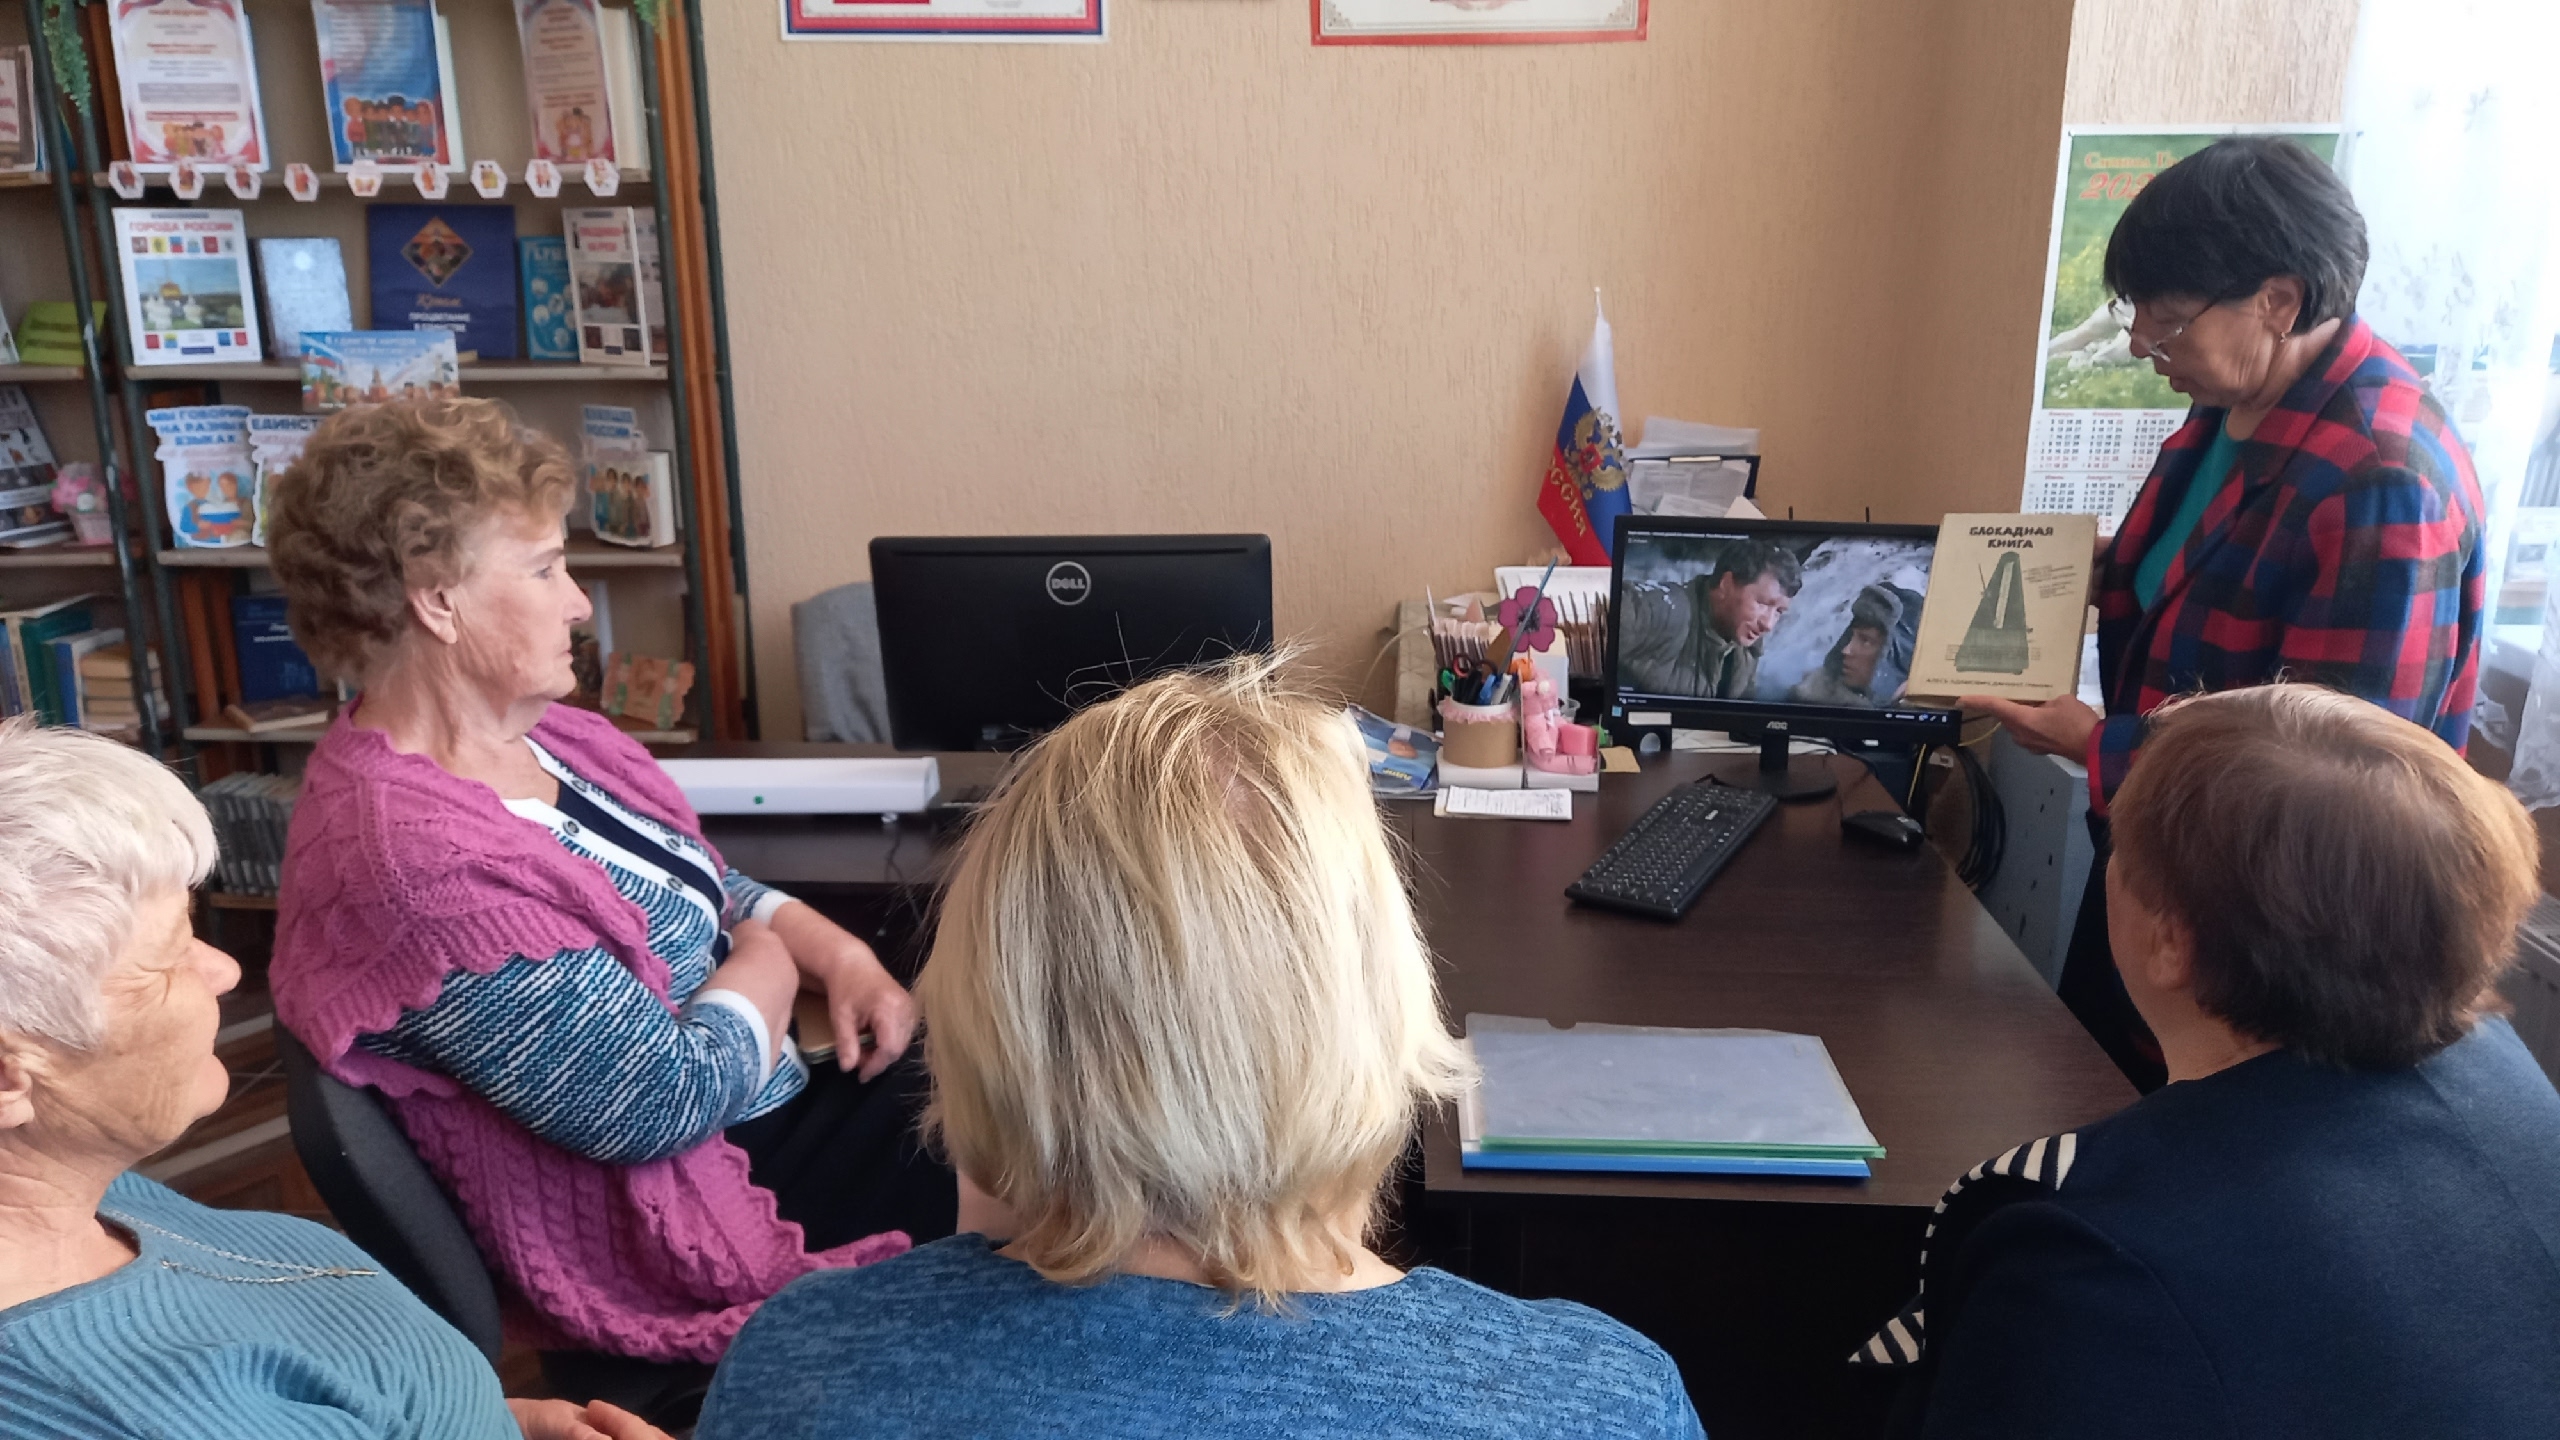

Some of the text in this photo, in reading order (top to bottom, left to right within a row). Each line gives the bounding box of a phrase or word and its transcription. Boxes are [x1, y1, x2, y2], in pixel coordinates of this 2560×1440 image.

[2080, 172, 2157, 199] 202
[129, 222, 235, 232] ГОРОДА РОССИИ
[252, 418, 318, 430] ЕДИНСТ
[1969, 526, 2054, 538] БЛОКАДНАЯ
[1987, 539, 2034, 548] КНИГА
[1051, 577, 1086, 590] DELL
[1766, 720, 1788, 730] AOC
